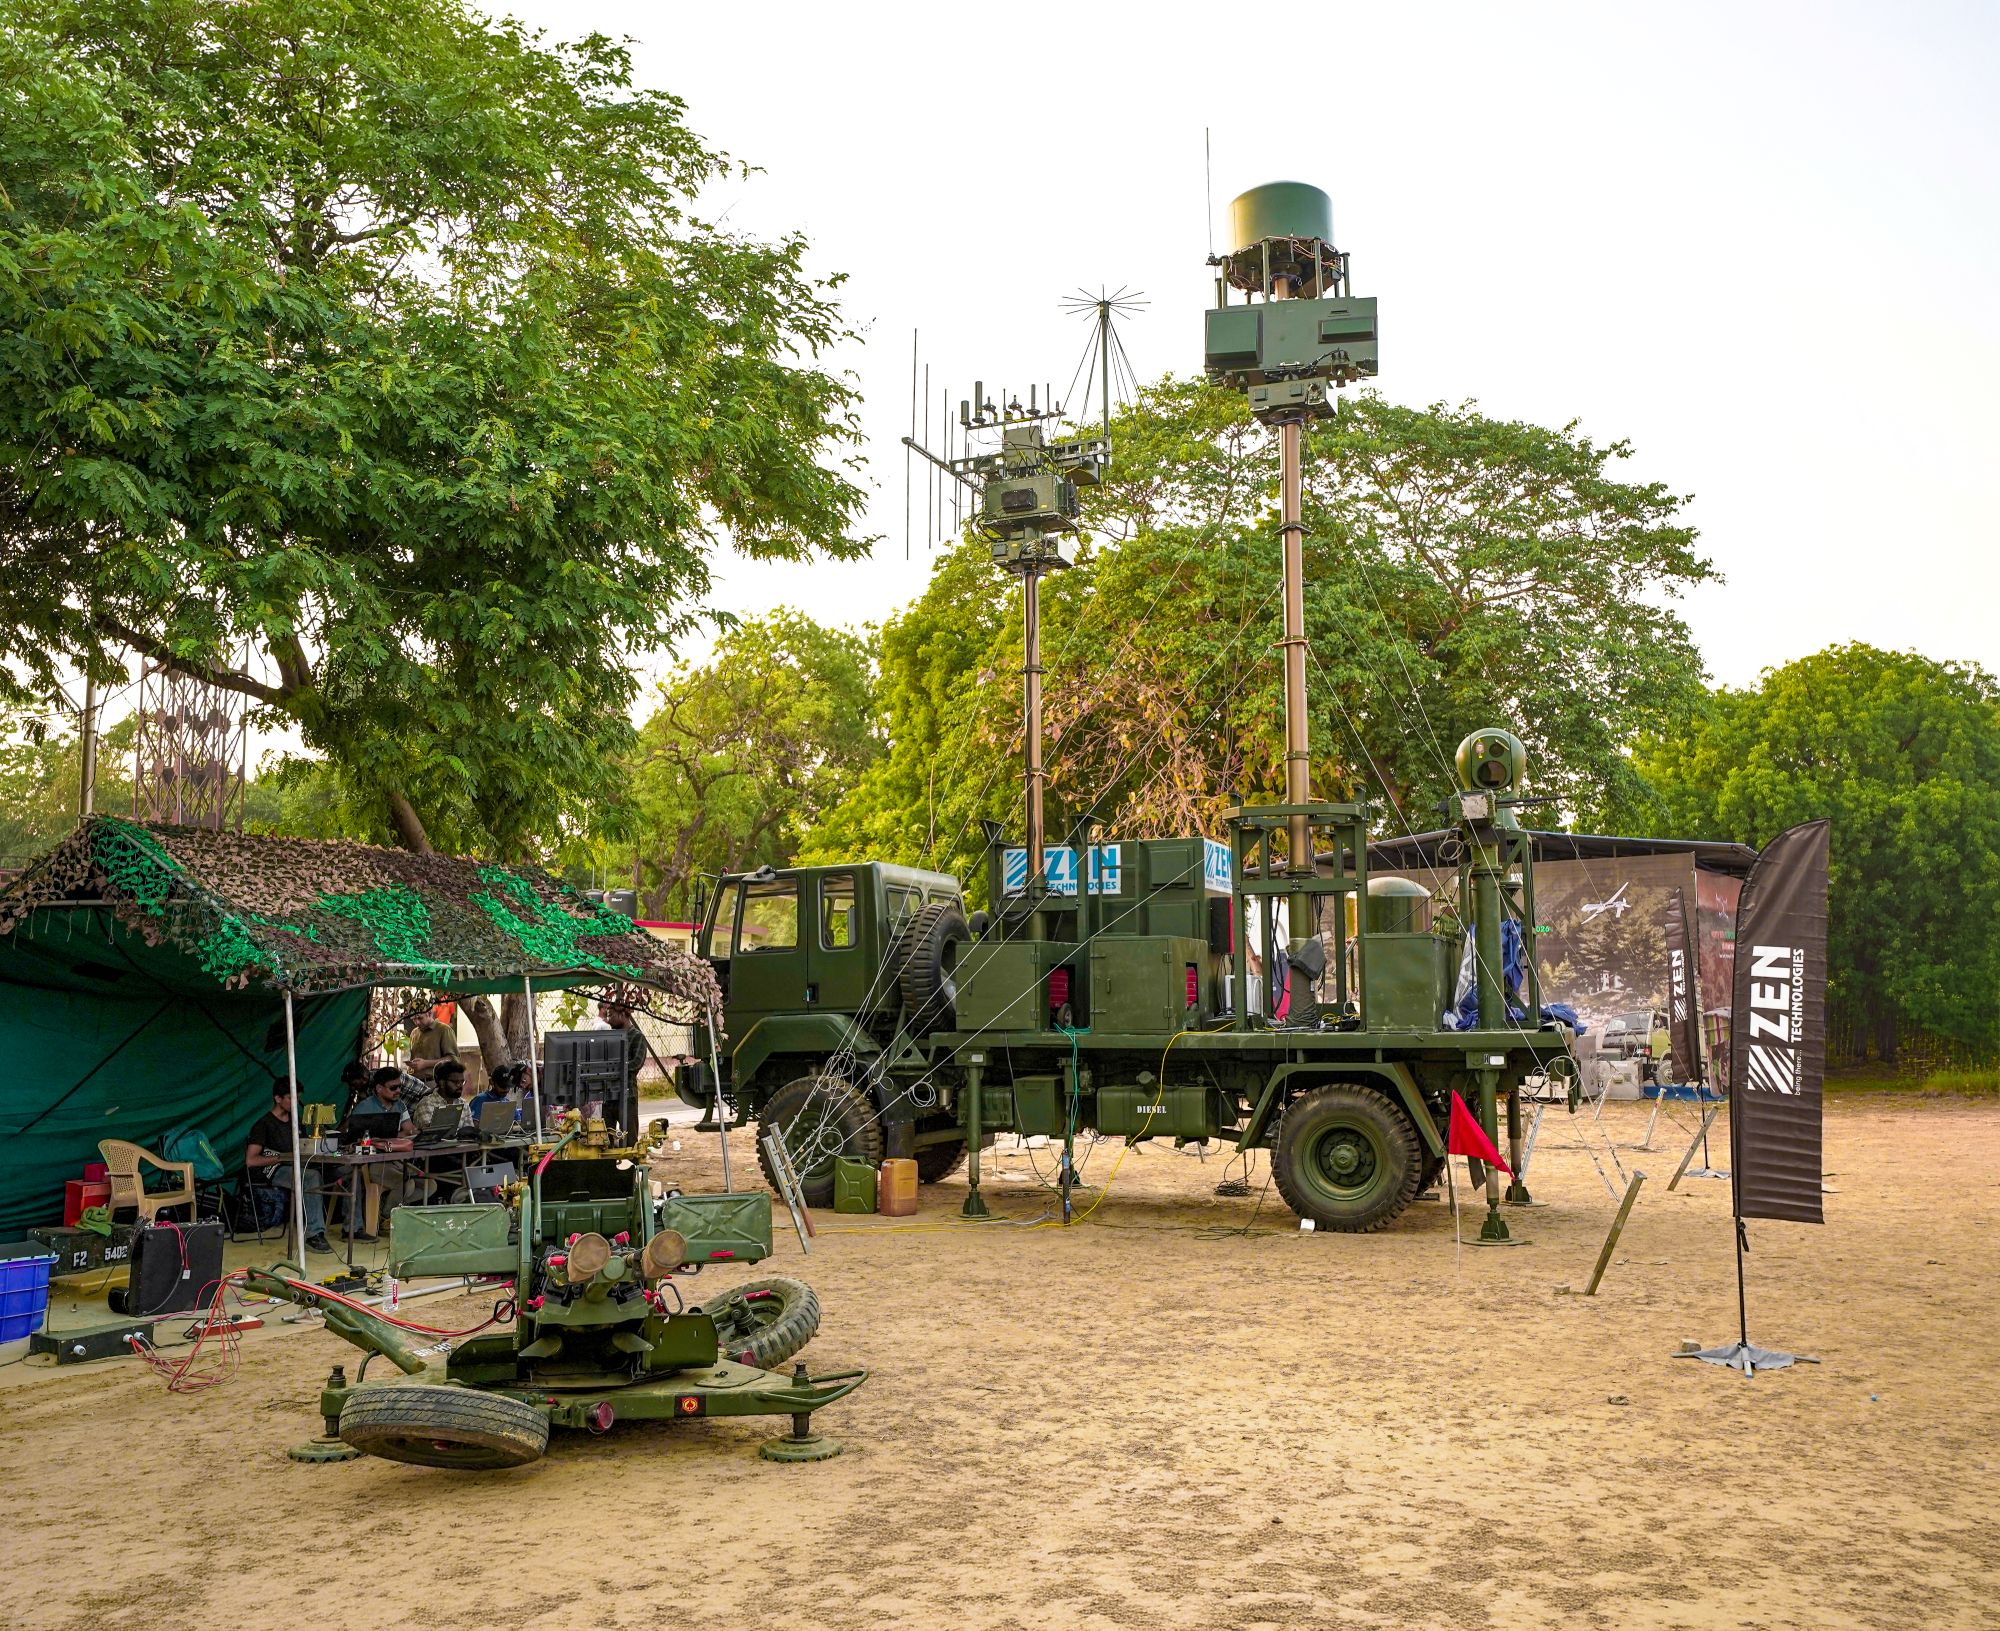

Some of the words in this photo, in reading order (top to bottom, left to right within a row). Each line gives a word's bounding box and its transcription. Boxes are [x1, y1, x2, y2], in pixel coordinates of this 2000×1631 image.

[1672, 949, 1684, 997] ZEN
[1750, 946, 1791, 1042] ZEN
[1791, 948, 1804, 1043] TECHNOLOGIES
[1136, 1105, 1167, 1114] DIESEL
[73, 1250, 88, 1267] F2
